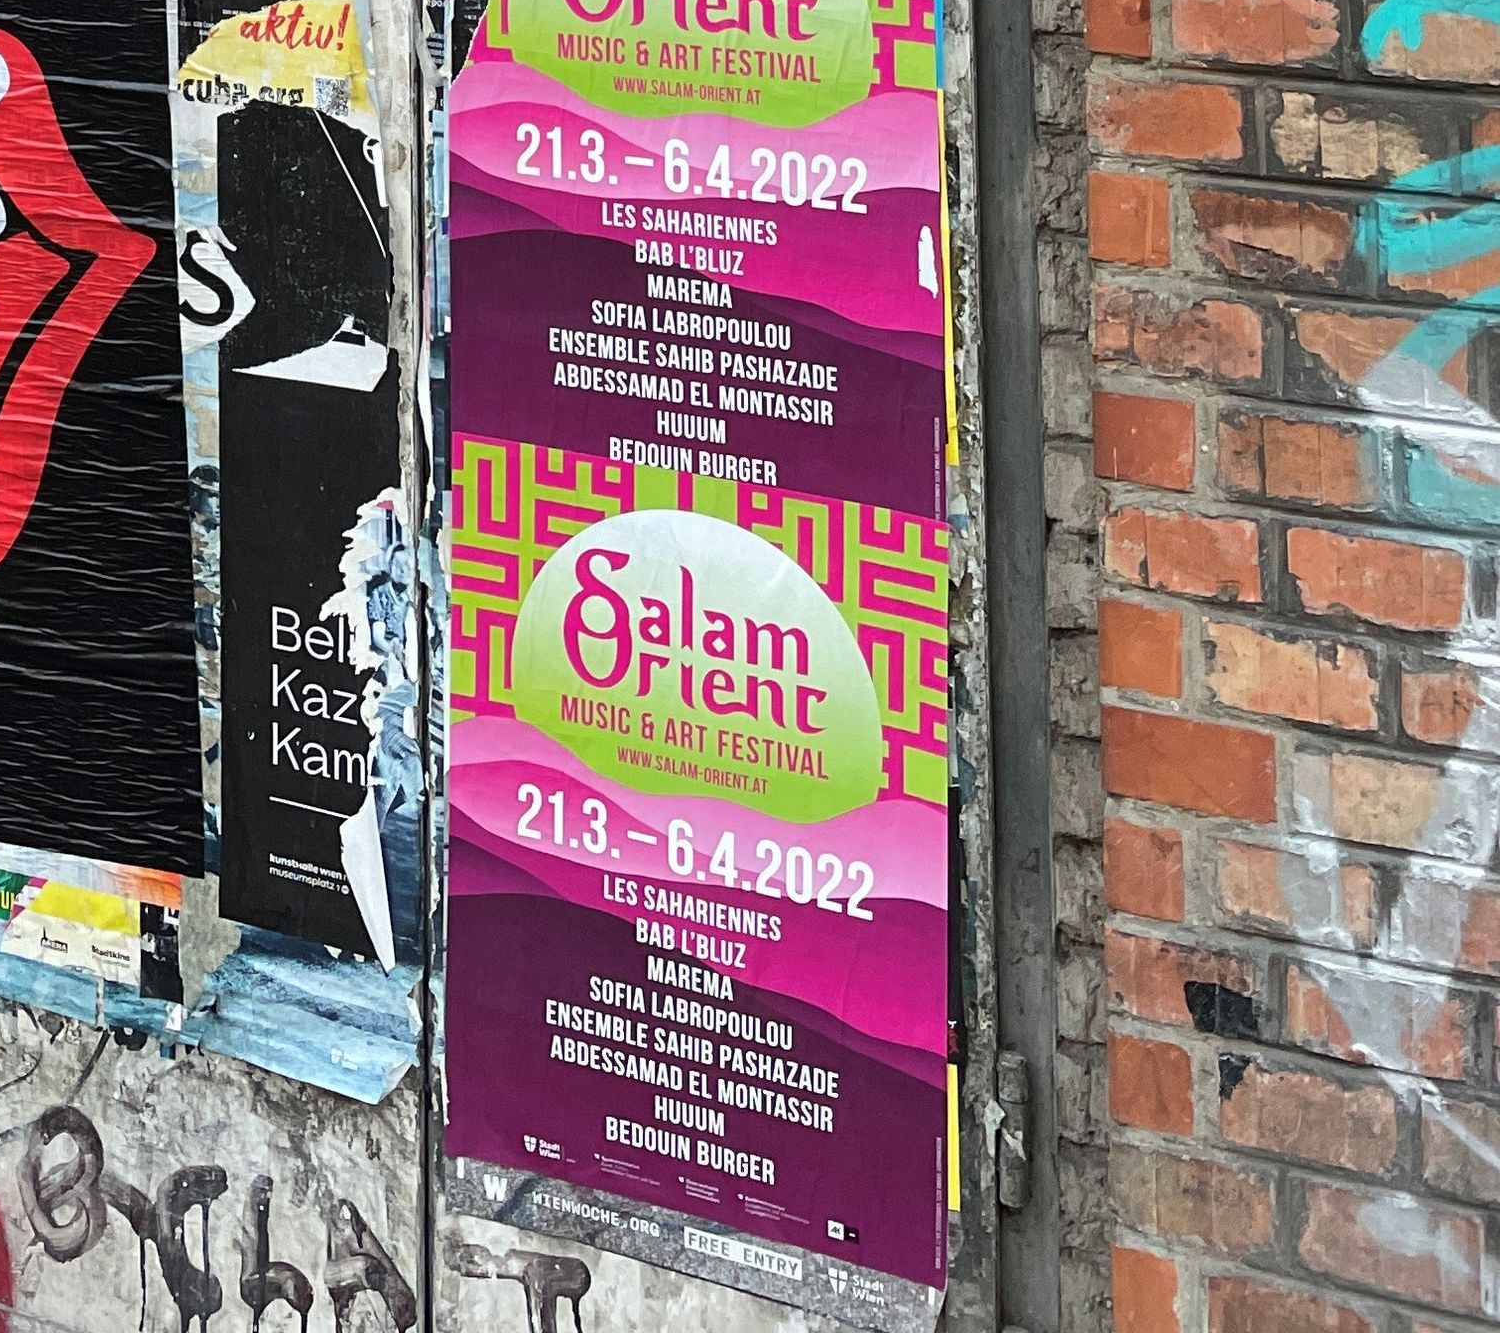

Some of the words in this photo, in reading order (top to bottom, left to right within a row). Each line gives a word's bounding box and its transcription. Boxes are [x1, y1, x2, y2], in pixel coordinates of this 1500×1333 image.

[240, 4, 351, 51] aktiv!
[557, 32, 626, 65] MUSIC
[636, 42, 650, 67] &
[658, 42, 701, 73] ART
[712, 47, 822, 85] FESTIVAL
[613, 77, 762, 106] WWW.SALAM-ORIENT.AT
[602, 202, 636, 229] LES
[642, 207, 777, 246] SAHARIENNES
[635, 240, 674, 267] BAB
[647, 274, 733, 309] MAREMA
[592, 300, 647, 331] SOFIA
[652, 308, 791, 351] LABROPOULOU
[549, 328, 650, 367] ENSEMBLE
[655, 344, 714, 374] SAHIB
[720, 352, 838, 392] PASHAZADE
[554, 362, 685, 404] ABDESSAMAD
[690, 383, 714, 409] EL
[719, 386, 834, 426] MONTASSIR
[657, 410, 726, 445] HUUUM
[609, 436, 693, 473] BEDOUIN
[699, 449, 778, 486] BURGER
[563, 548, 810, 676] Salam
[563, 629, 829, 735] Orient
[562, 695, 631, 735] MUSIC
[641, 710, 656, 742] &
[664, 713, 708, 753] ART
[718, 730, 829, 781] FESTIVAL
[617, 746, 768, 797] WWW.SALAM-ORIENT.AT
[269, 867, 335, 891] museumsplatz
[603, 874, 638, 907] LES
[644, 880, 782, 941] SAHARIENNES
[636, 917, 676, 951] BAB
[648, 955, 733, 1002] MAREMA
[590, 976, 646, 1017] SOFIA
[652, 990, 793, 1051] LABROPOULOU
[546, 1000, 648, 1049] ENSEMBLE
[654, 1027, 714, 1065] SAHIB
[720, 1044, 839, 1099] PASHAZADE
[550, 1035, 683, 1092] ABDESSAMAD
[689, 1068, 713, 1099] EL
[717, 1076, 834, 1133] MONTASSIR
[654, 1094, 725, 1137] HUUUM
[606, 1116, 690, 1164] BEDOUIN
[696, 1138, 776, 1186] BURGER
[688, 1231, 730, 1257] FREE
[744, 1247, 799, 1276] ENTRY
[853, 1274, 885, 1293] Stadt
[853, 1289, 885, 1306] Wien
